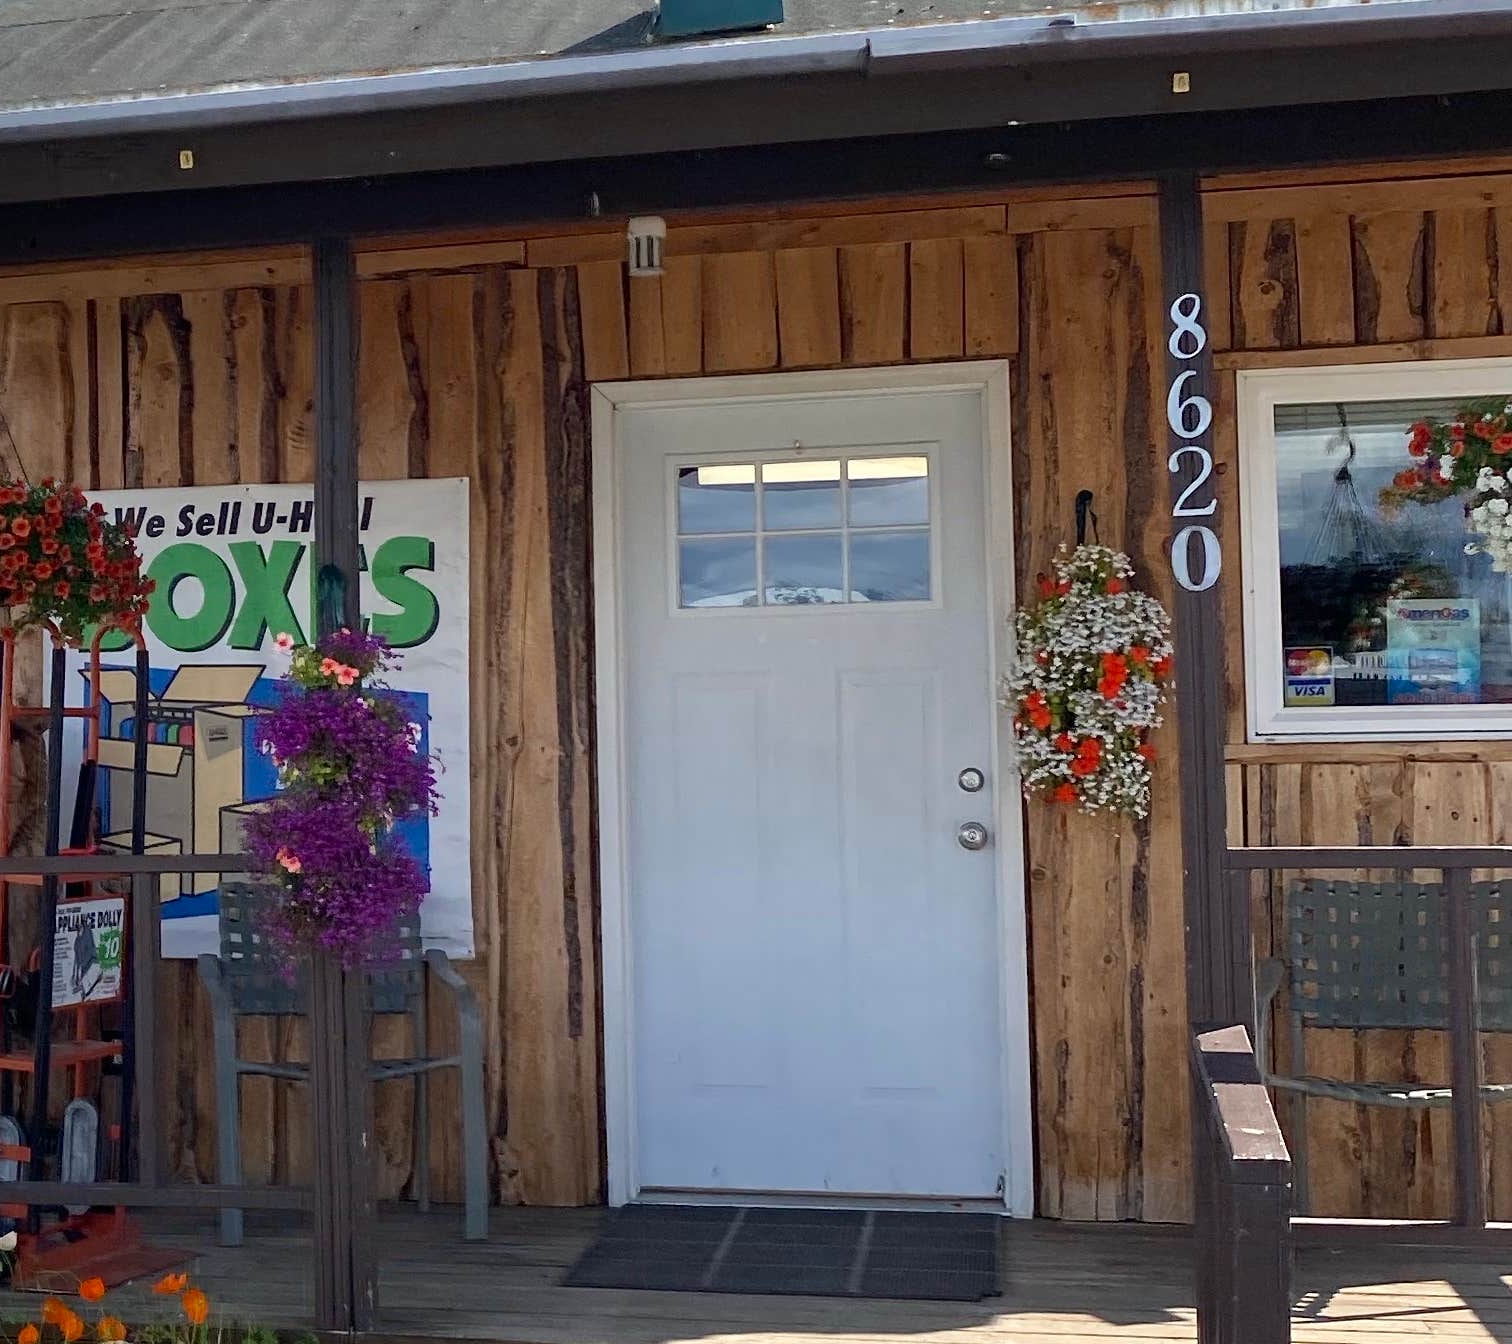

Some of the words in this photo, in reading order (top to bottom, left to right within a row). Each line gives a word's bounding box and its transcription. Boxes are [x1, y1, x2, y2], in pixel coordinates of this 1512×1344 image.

[1166, 293, 1223, 592] 8620
[114, 506, 166, 538] We
[176, 501, 242, 537] Sell
[252, 496, 375, 534] U-Hl
[79, 535, 440, 653] OXS
[1294, 686, 1326, 698] VISA
